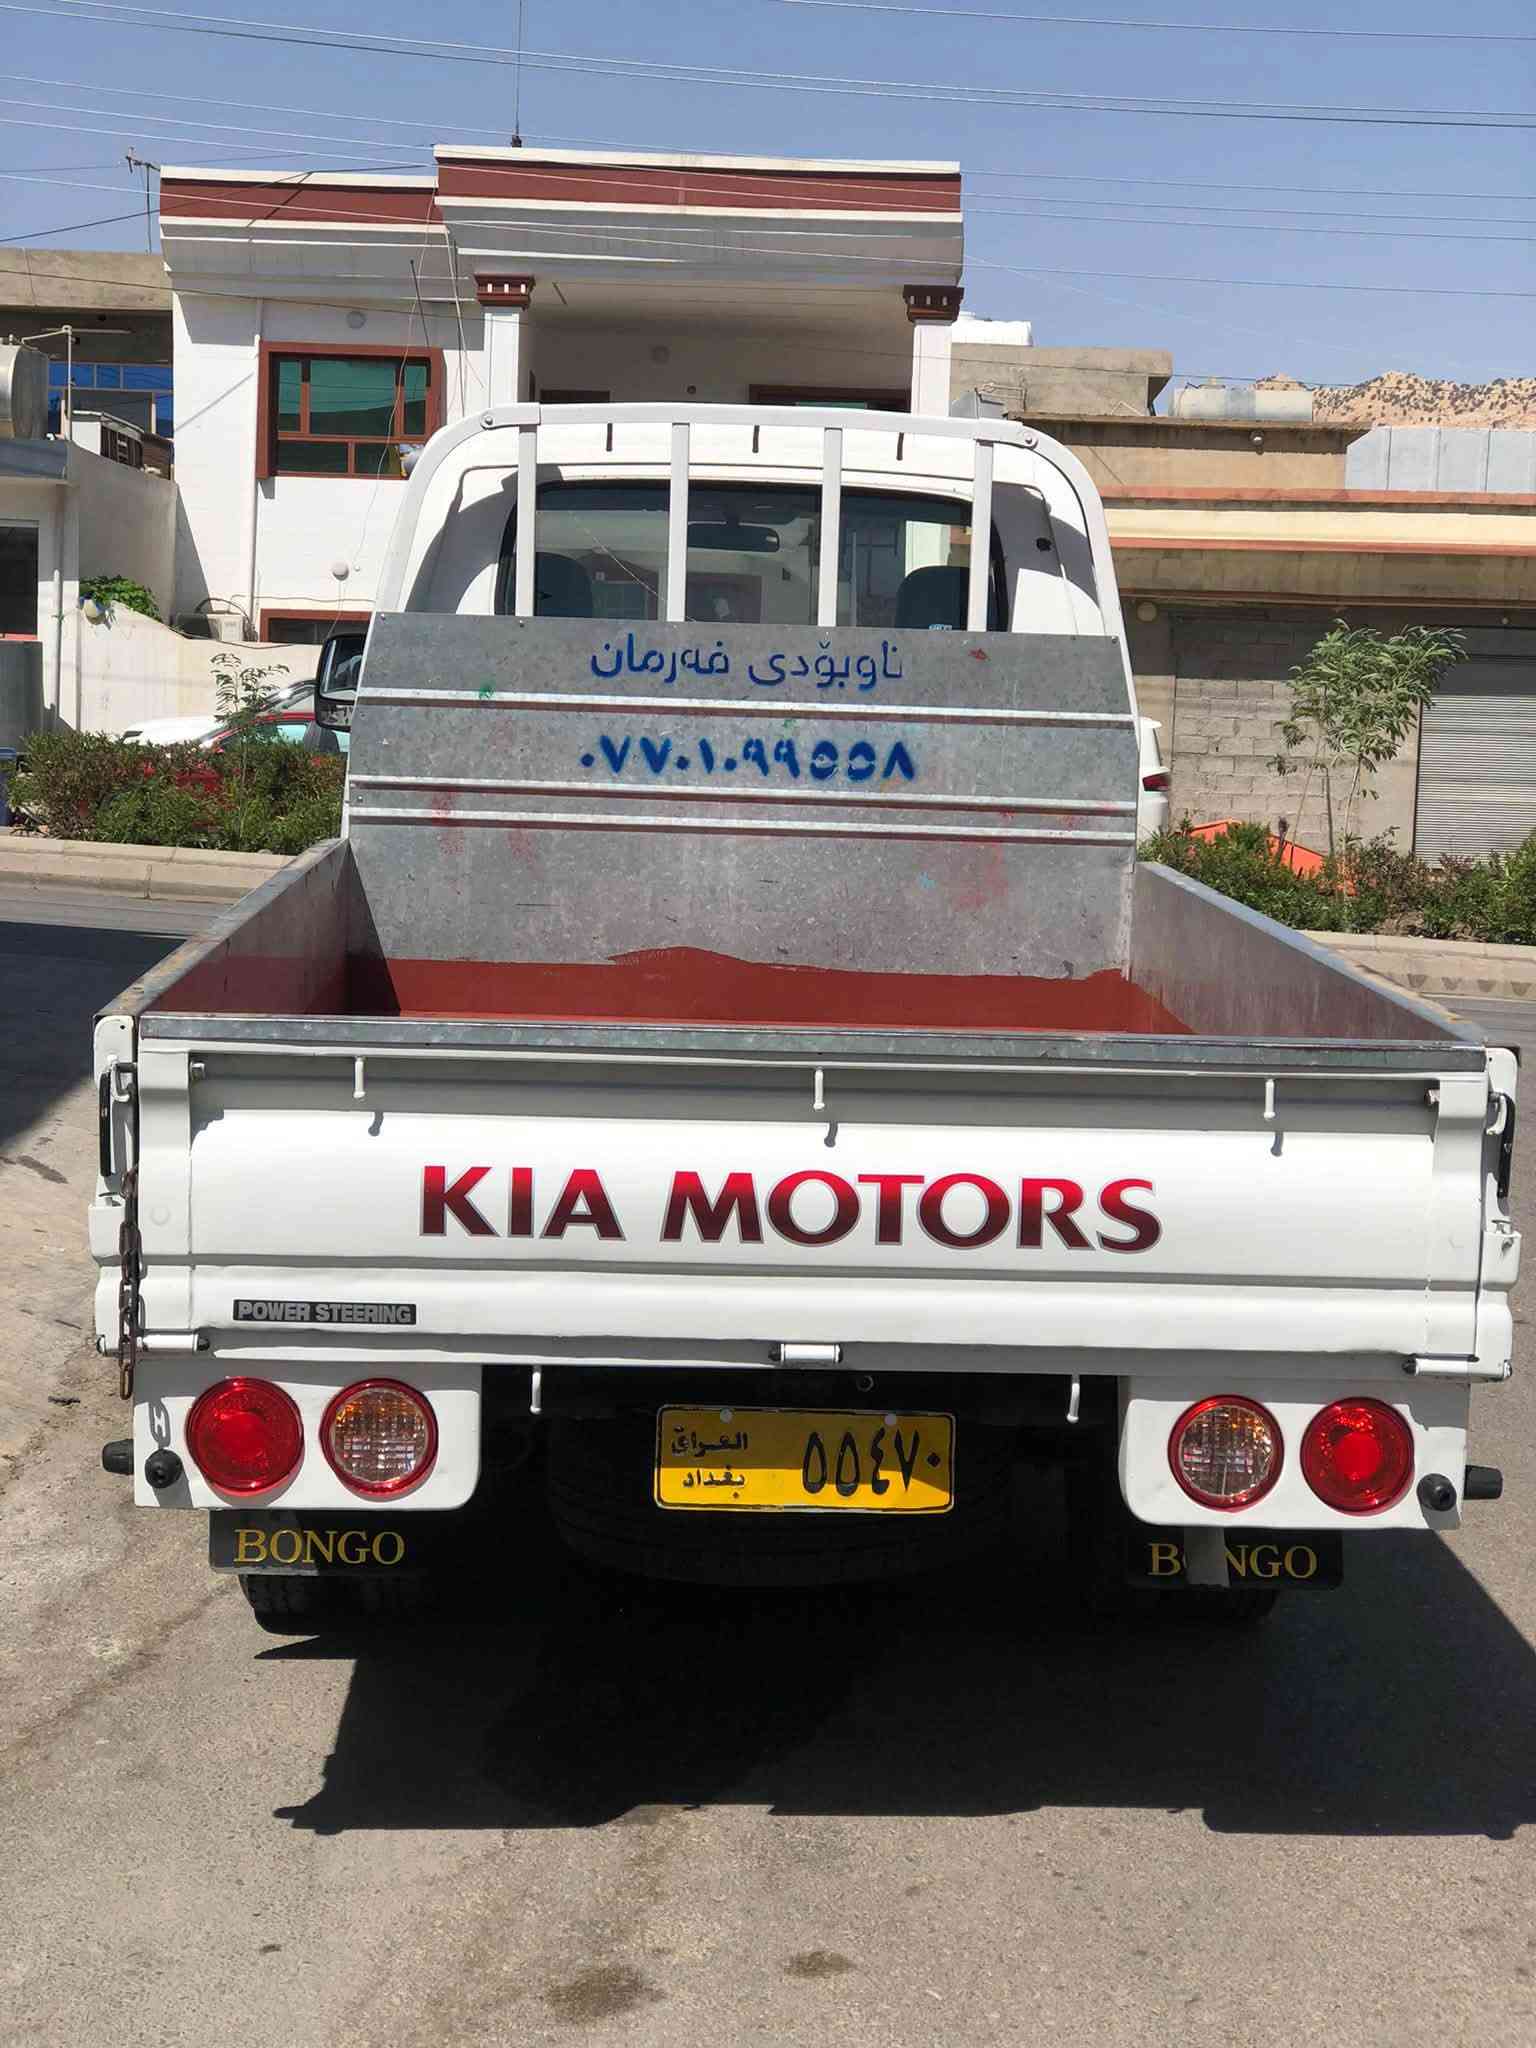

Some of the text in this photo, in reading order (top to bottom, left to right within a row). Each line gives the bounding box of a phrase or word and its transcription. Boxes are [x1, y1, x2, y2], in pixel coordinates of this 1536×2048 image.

[579, 734, 916, 781] ٠٧٧٠١٠٩٩٥٥٨
[418, 1164, 1163, 1255] KIA MOTORS
[237, 1301, 411, 1324] POWER STEERING
[671, 1424, 748, 1458] العراق
[802, 1427, 941, 1497] ٥٥٤٧٠
[682, 1464, 746, 1499] بغداد
[233, 1528, 405, 1565] BONGO
[1147, 1542, 1318, 1579] BNGO
